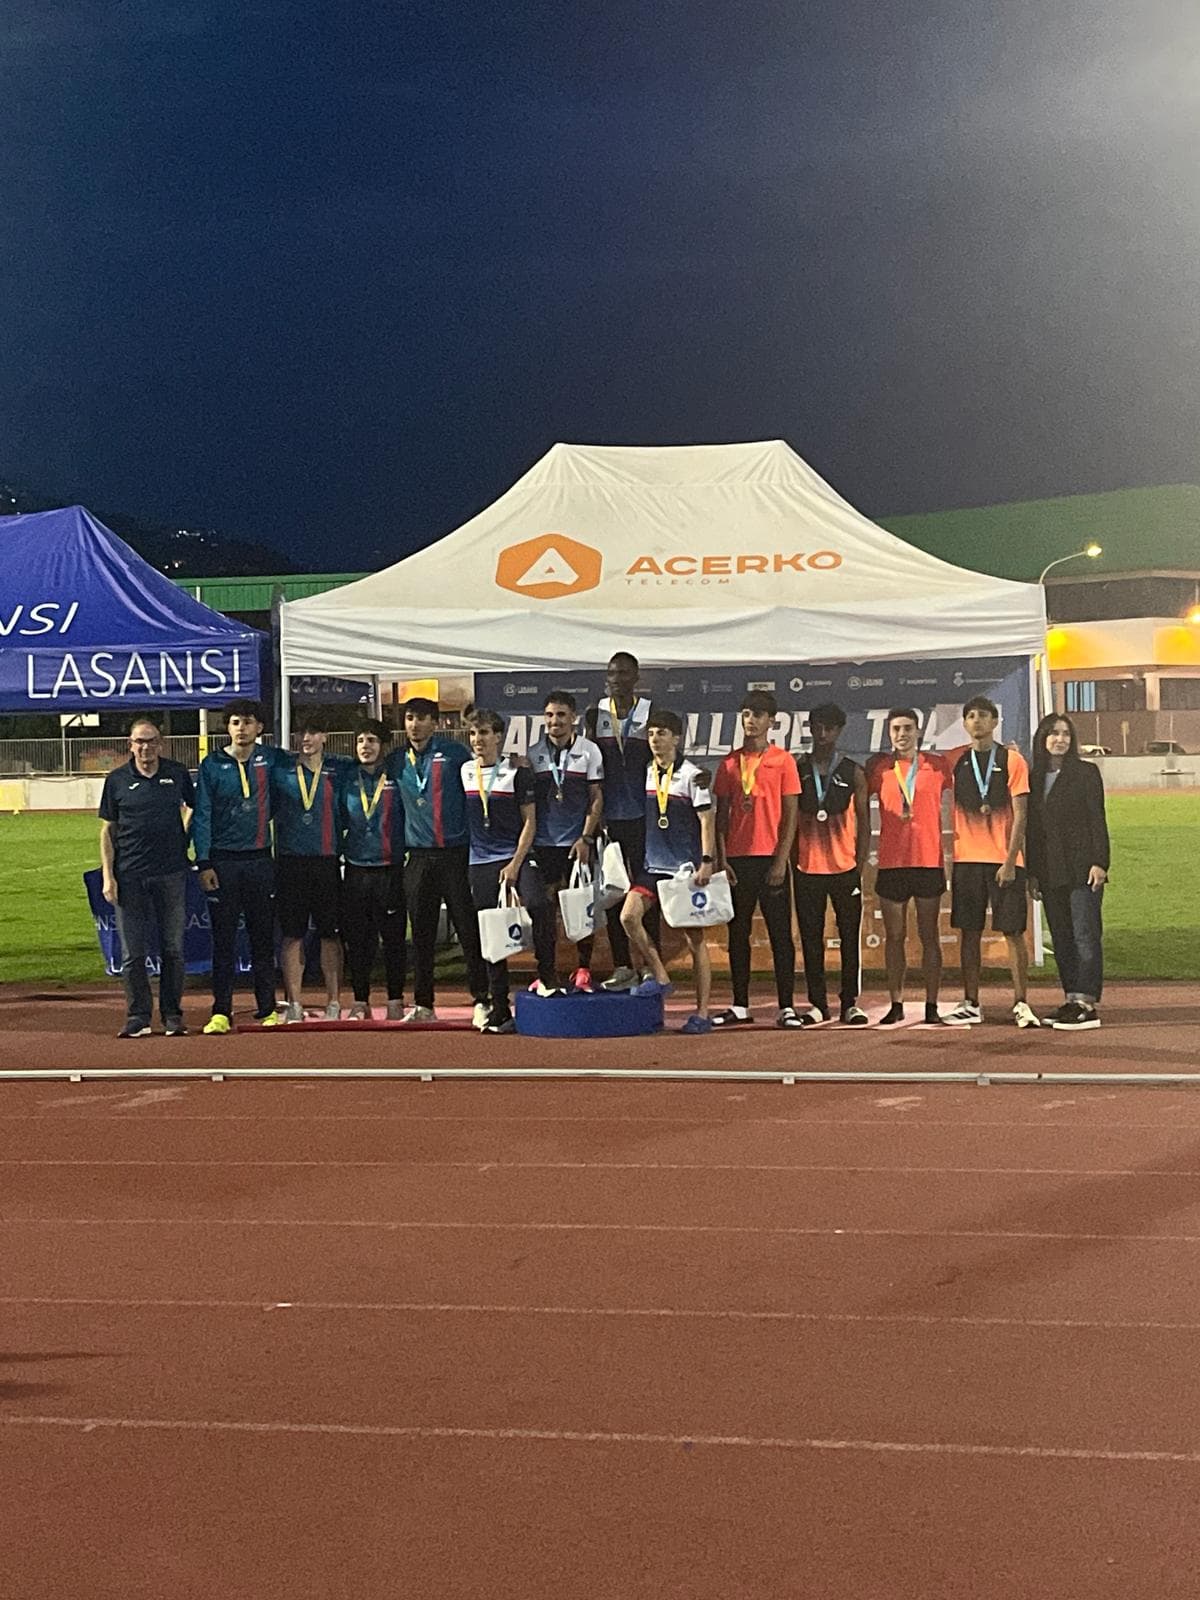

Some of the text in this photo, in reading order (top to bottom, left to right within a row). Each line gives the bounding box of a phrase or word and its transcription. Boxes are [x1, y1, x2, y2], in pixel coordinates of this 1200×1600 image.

[625, 551, 843, 576] ACERKO
[625, 578, 731, 586] TELECOM
[27, 649, 241, 699] LASANSI
